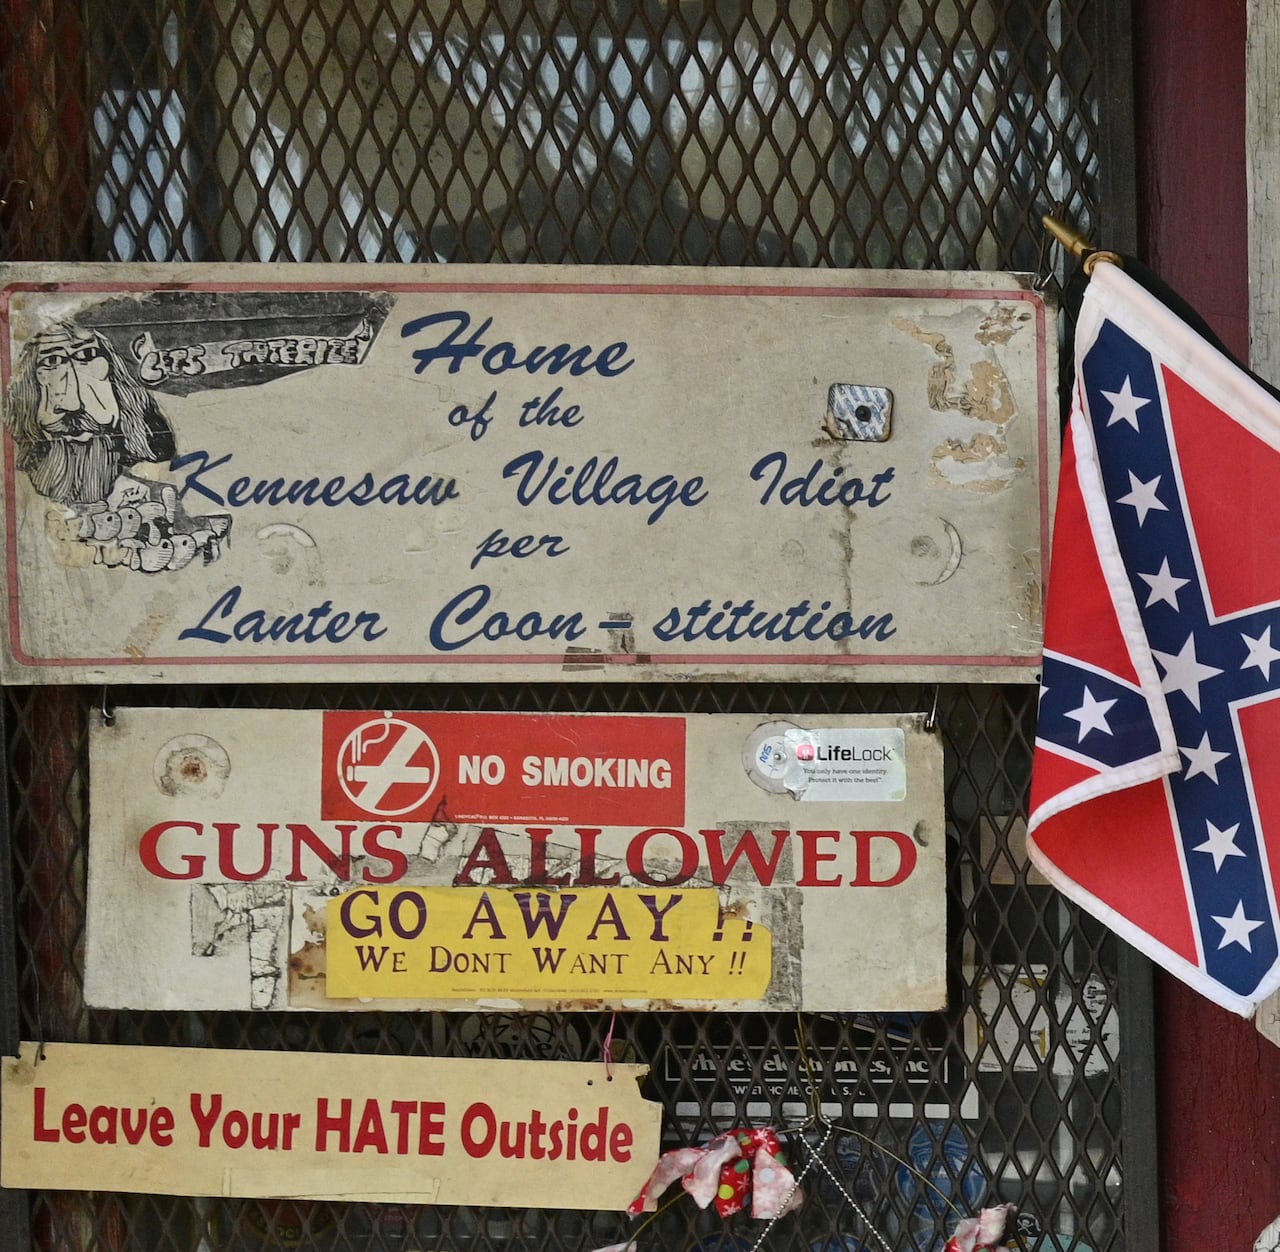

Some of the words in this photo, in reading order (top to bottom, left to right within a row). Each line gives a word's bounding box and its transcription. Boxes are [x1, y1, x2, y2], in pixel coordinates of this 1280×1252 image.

[401, 310, 636, 378] Home
[447, 394, 495, 441] of
[519, 388, 585, 429] the
[168, 449, 459, 508] Kennesaw
[503, 452, 707, 531] Village
[750, 452, 895, 508] Idiot
[470, 524, 571, 582] per
[179, 586, 388, 646] Lanter
[652, 595, 899, 644] stitution
[458, 755, 506, 785] NO
[522, 756, 672, 788] SMOKING
[817, 746, 892, 761] LifeLock
[138, 820, 410, 885] GUNS
[454, 827, 919, 889] ALLOWED
[339, 891, 429, 942] GO
[461, 893, 684, 942] AWAY
[33, 1087, 175, 1147] Leave
[190, 1092, 302, 1151] Your
[315, 1097, 446, 1158] HATE
[460, 1101, 633, 1163] Outside
